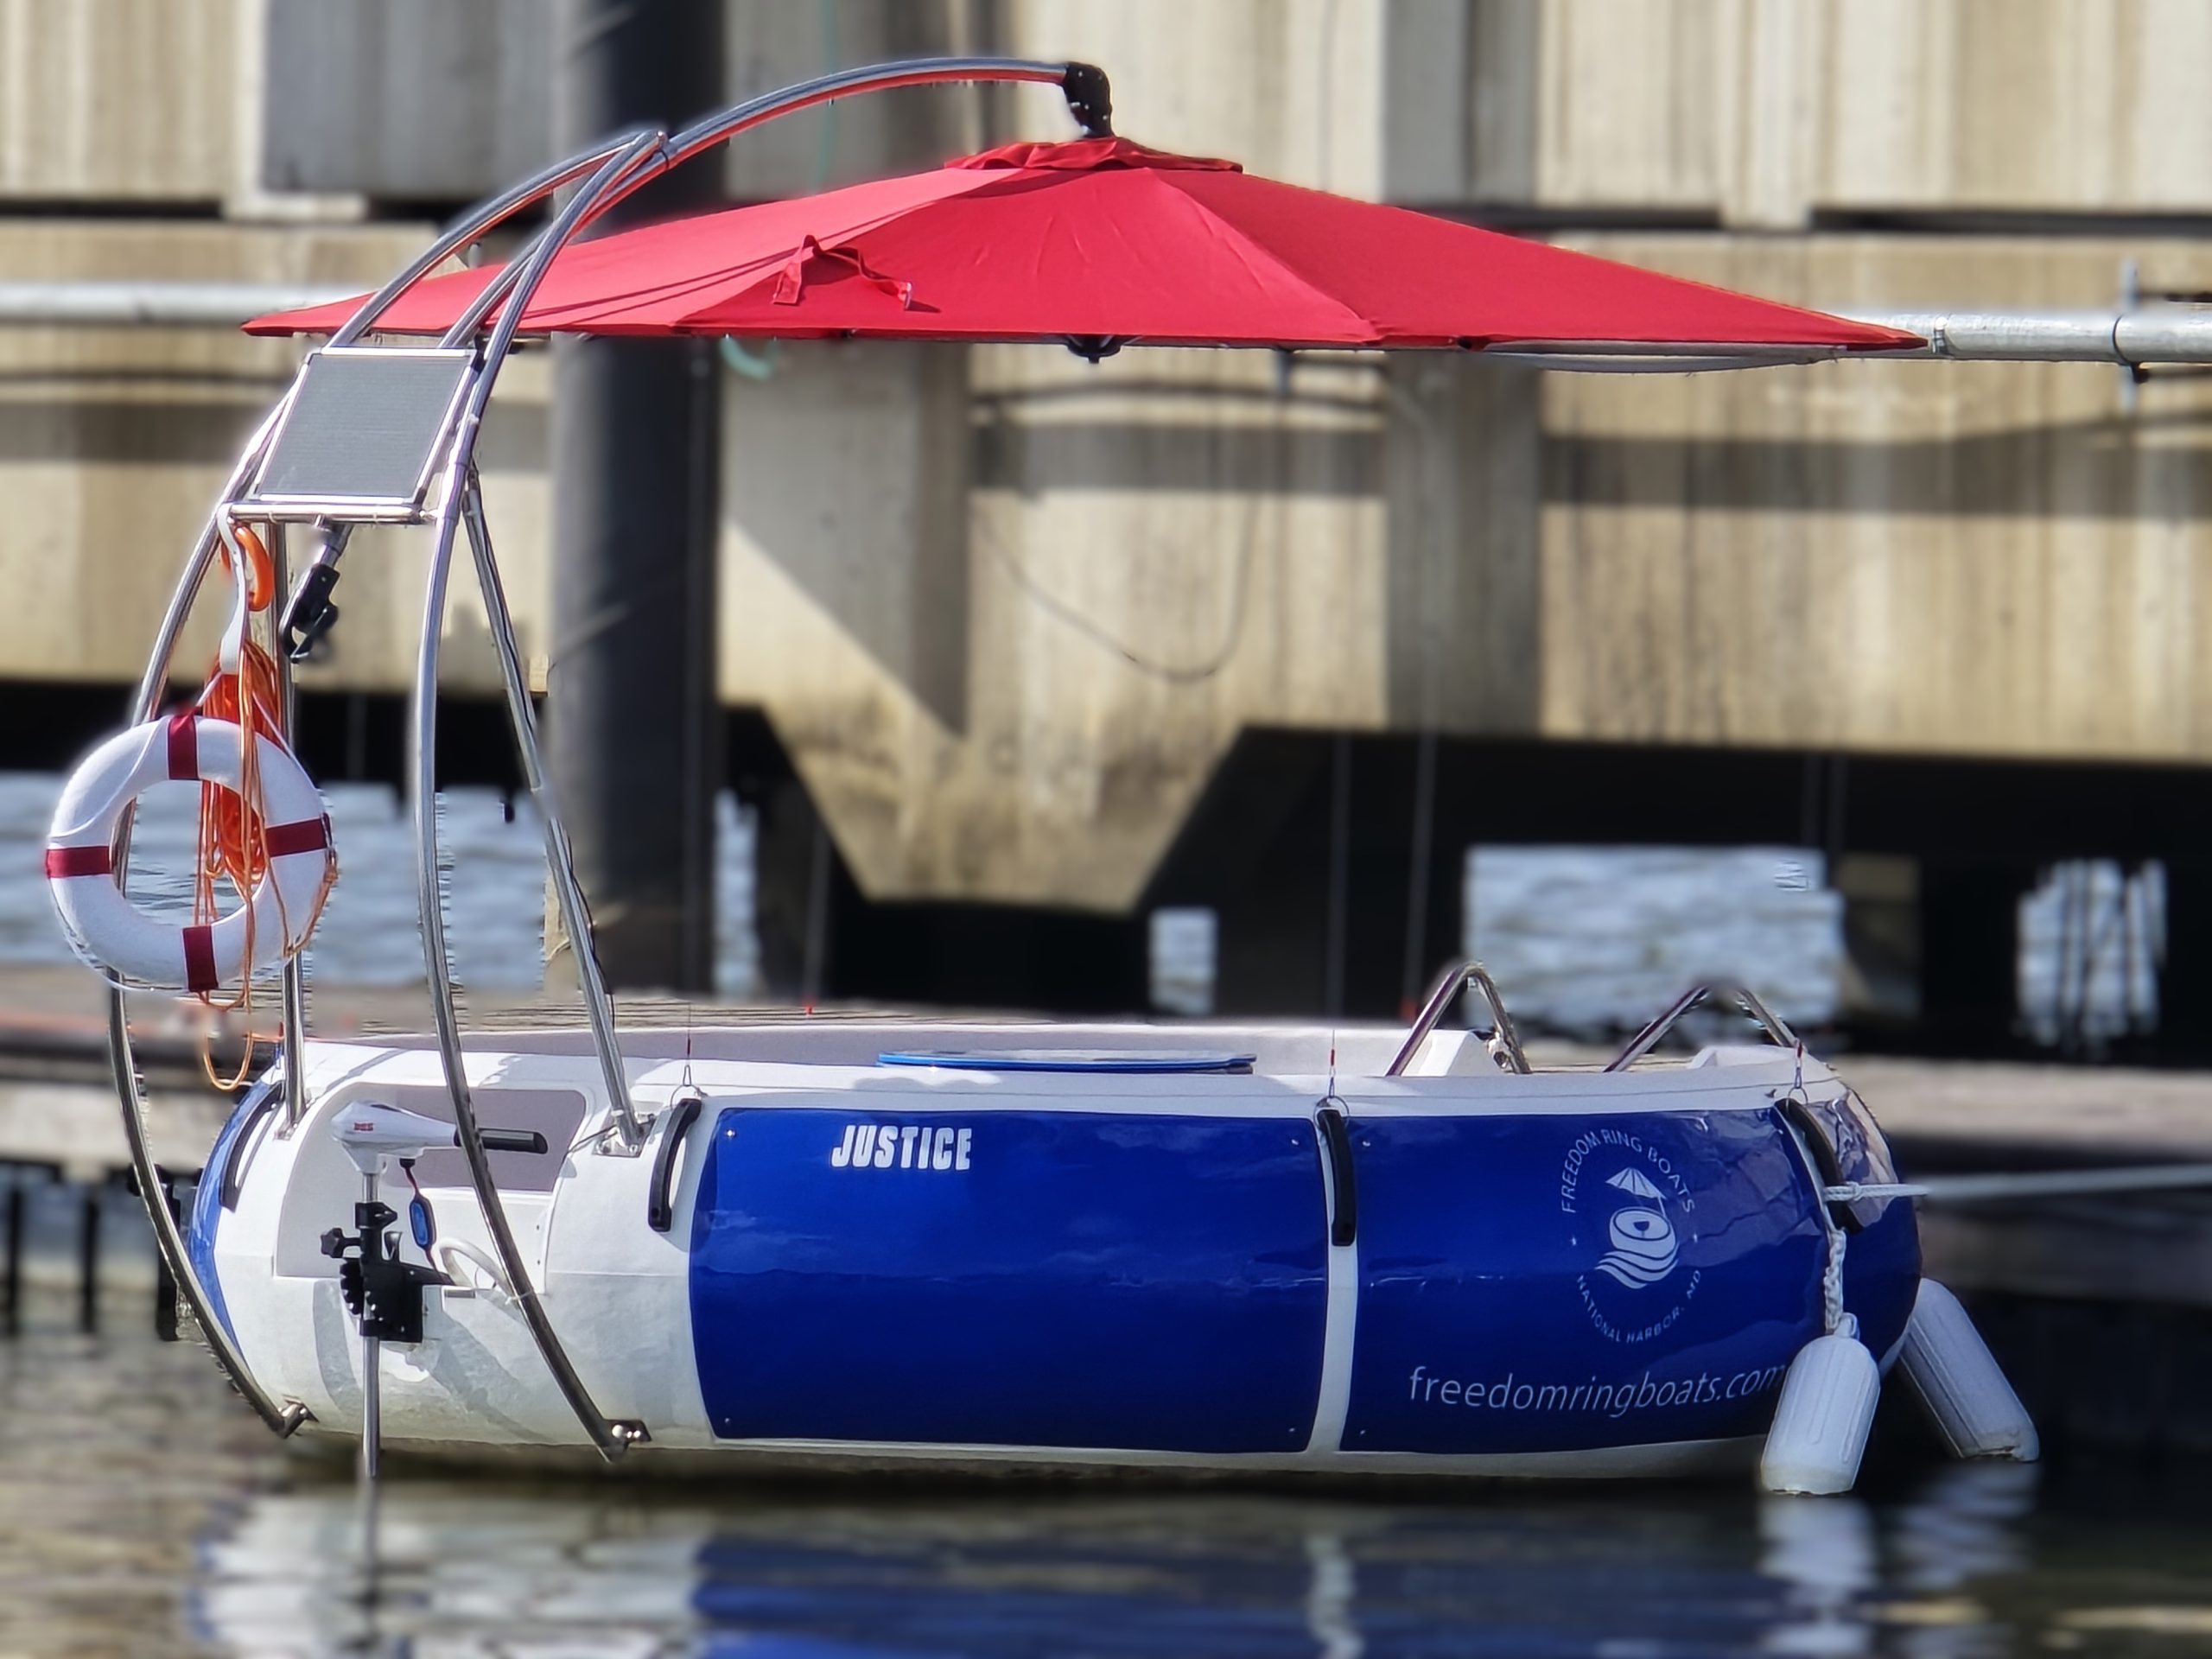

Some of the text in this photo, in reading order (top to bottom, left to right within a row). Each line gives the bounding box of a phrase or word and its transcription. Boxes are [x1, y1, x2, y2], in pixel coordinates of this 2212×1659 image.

[831, 1125, 972, 1170] JUSTICE
[1561, 1128, 1695, 1213] FREEDOM RING BOATS
[1577, 1274, 1621, 1342] NATIONAL
[1686, 1269, 1701, 1300] MD
[1410, 1365, 1785, 1418] freedomringboats.com
